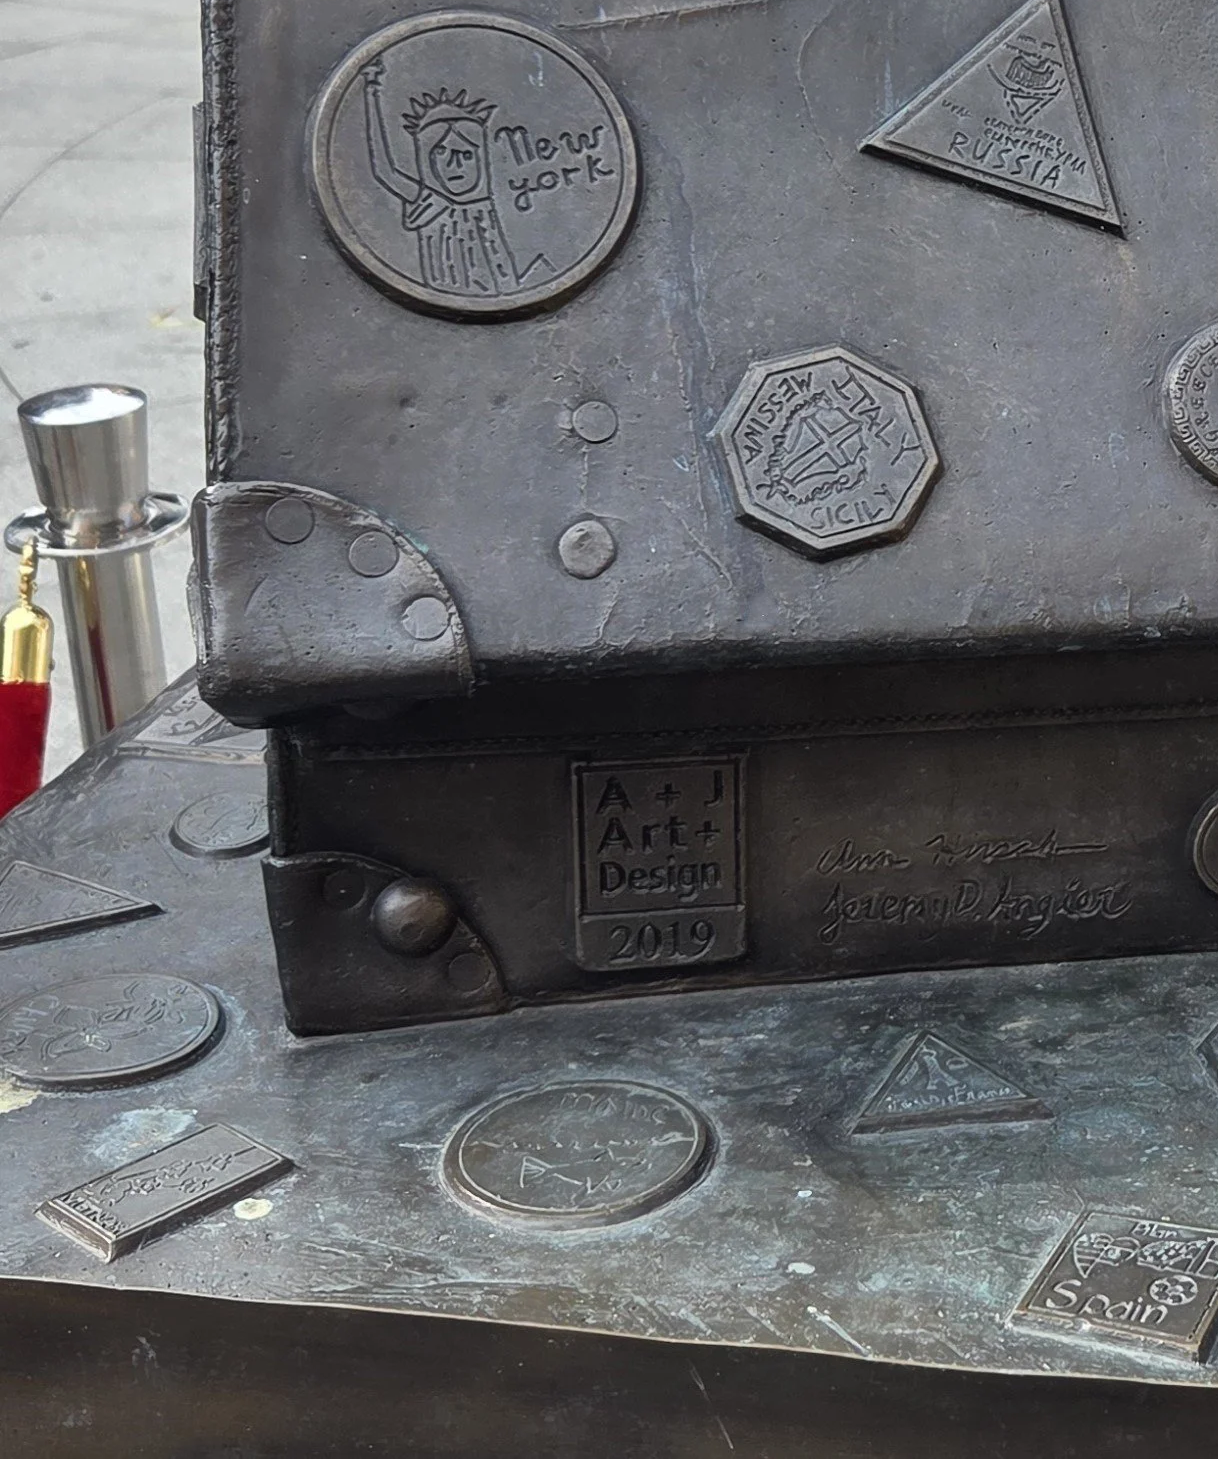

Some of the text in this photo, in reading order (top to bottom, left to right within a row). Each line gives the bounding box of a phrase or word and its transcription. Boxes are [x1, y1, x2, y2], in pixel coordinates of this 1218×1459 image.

[948, 131, 1061, 190] RUSSIA
[743, 371, 813, 465] MESSINA
[831, 365, 922, 467] ITALY
[810, 482, 897, 530] SICILY
[596, 769, 725, 816] A + J
[597, 816, 722, 856] Art +
[600, 854, 722, 904] Design
[608, 920, 717, 965] 2019
[1044, 1278, 1169, 1326] Spain
